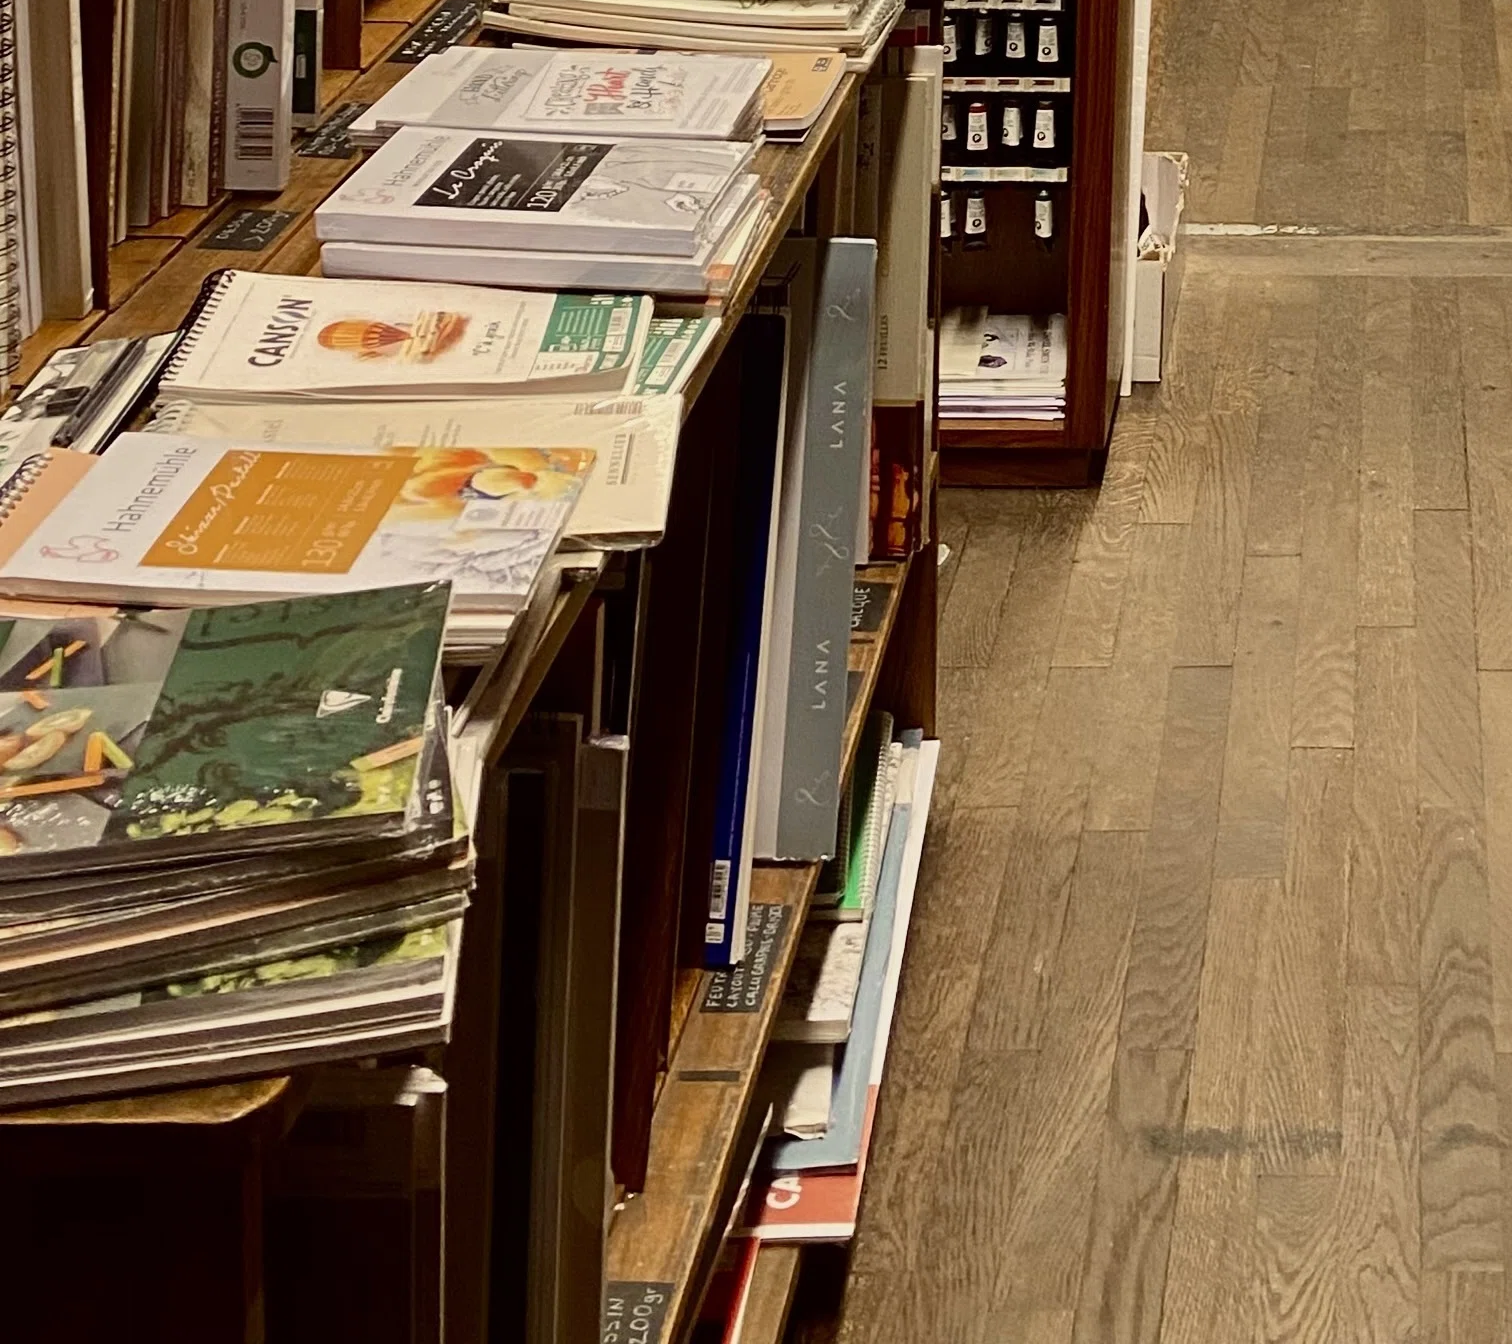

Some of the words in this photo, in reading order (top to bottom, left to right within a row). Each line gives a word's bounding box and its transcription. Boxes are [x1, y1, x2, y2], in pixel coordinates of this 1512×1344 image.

[450, 140, 504, 181] Croquis
[526, 188, 559, 209] 120
[247, 296, 313, 367] CANSON
[829, 380, 848, 449] LANA
[92, 446, 197, 533] Hahnemühle
[301, 538, 344, 568] 130
[811, 638, 831, 711] LANA
